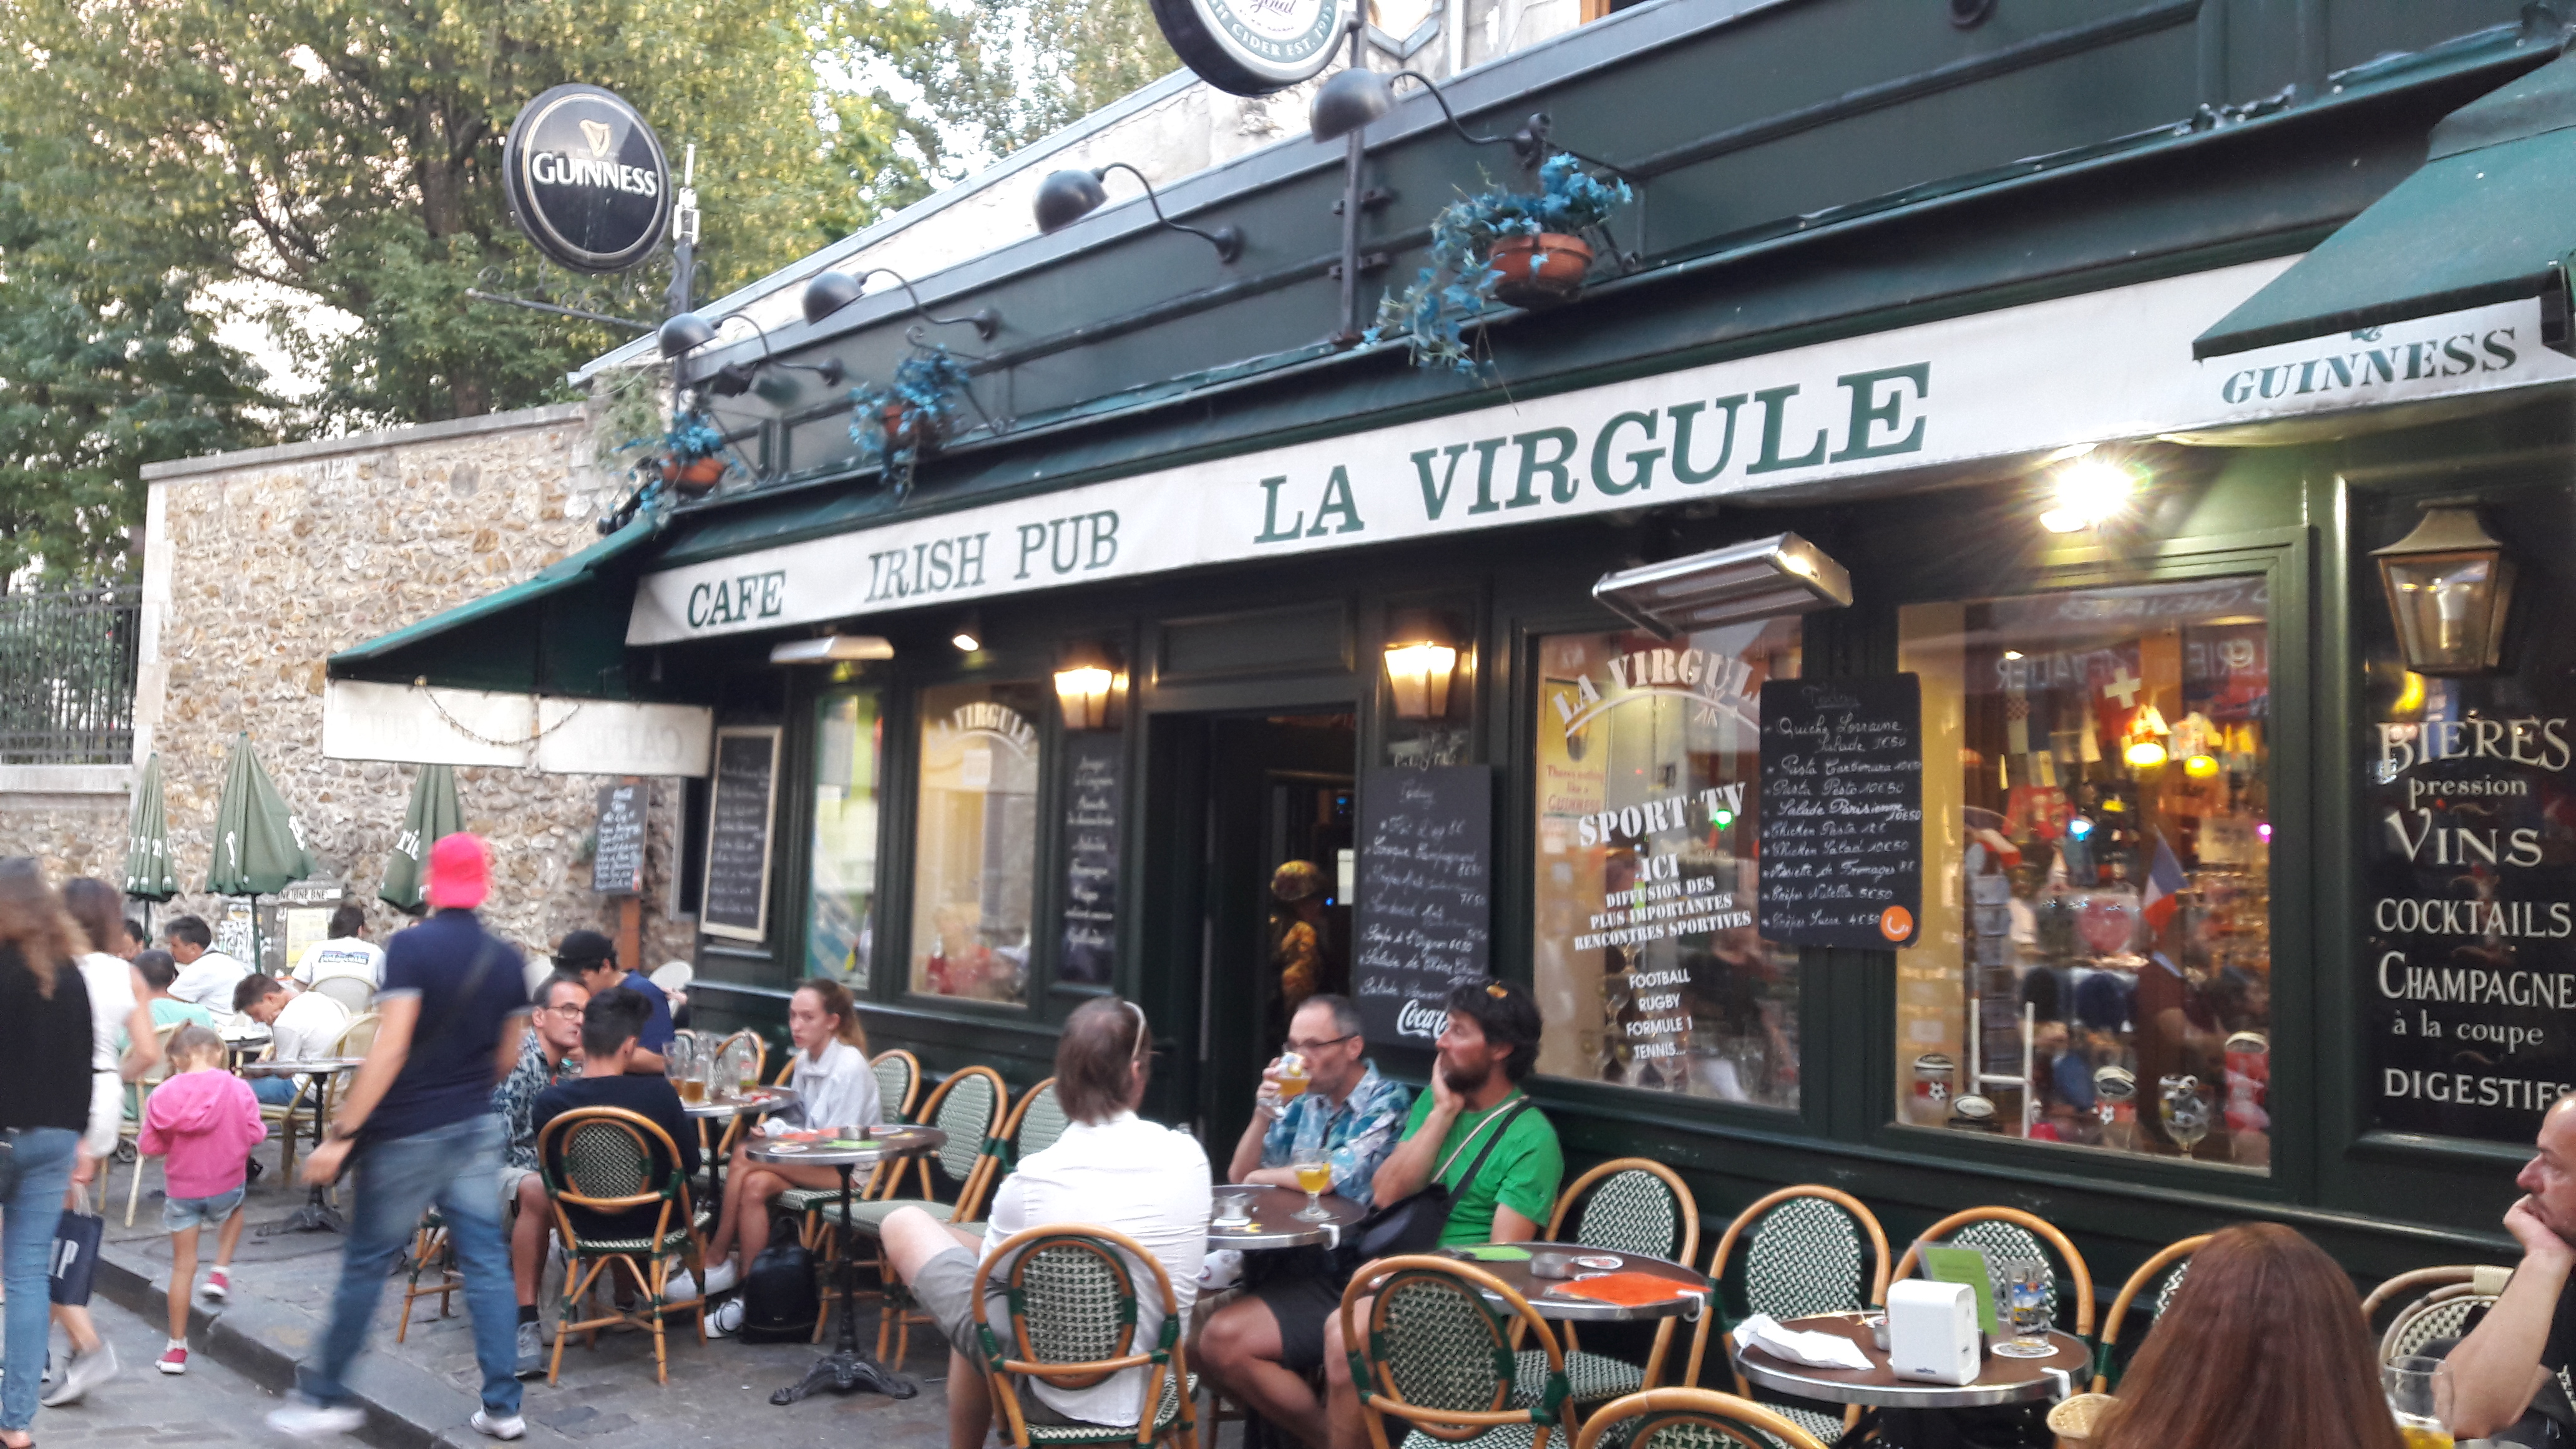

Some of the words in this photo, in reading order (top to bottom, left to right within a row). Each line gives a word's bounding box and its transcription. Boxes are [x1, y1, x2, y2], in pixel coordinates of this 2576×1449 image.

[1231, 22, 1281, 57] CIDER
[532, 152, 657, 198] GUINNESS
[2222, 326, 2517, 405] GUINNESS
[687, 570, 786, 630] CAFE
[864, 532, 991, 604] IRISH
[1013, 509, 1121, 580] PUB
[1253, 464, 1364, 545] LA
[1409, 361, 1931, 522] VIRGULE
[1553, 673, 1601, 724] LA
[1606, 648, 1760, 706] VIRGUL
[2408, 774, 2527, 811] pression
[1578, 794, 1688, 847] SPORT
[1699, 782, 1747, 822] TV
[2384, 807, 2544, 867] VINS
[1641, 852, 1680, 882] ICI
[1590, 909, 1626, 930] PLUS
[1629, 892, 1734, 924] IMPORTANTES
[1605, 881, 1682, 909] DIFFUSION
[1686, 874, 1715, 894] DES
[1573, 924, 1665, 951] RENCONTRES
[1668, 909, 1752, 937] SPORTIVES
[2375, 897, 2573, 938] COCKTAILS
[1628, 967, 1692, 990] FOOTBALL
[2378, 950, 2576, 1010] CHAMPAGNE
[1637, 993, 1681, 1012] RUGBY
[1625, 1018, 1684, 1037] FORMULE
[1686, 1015, 1694, 1031] 1
[2419, 1008, 2442, 1038] la
[2456, 1022, 2545, 1055] coupe
